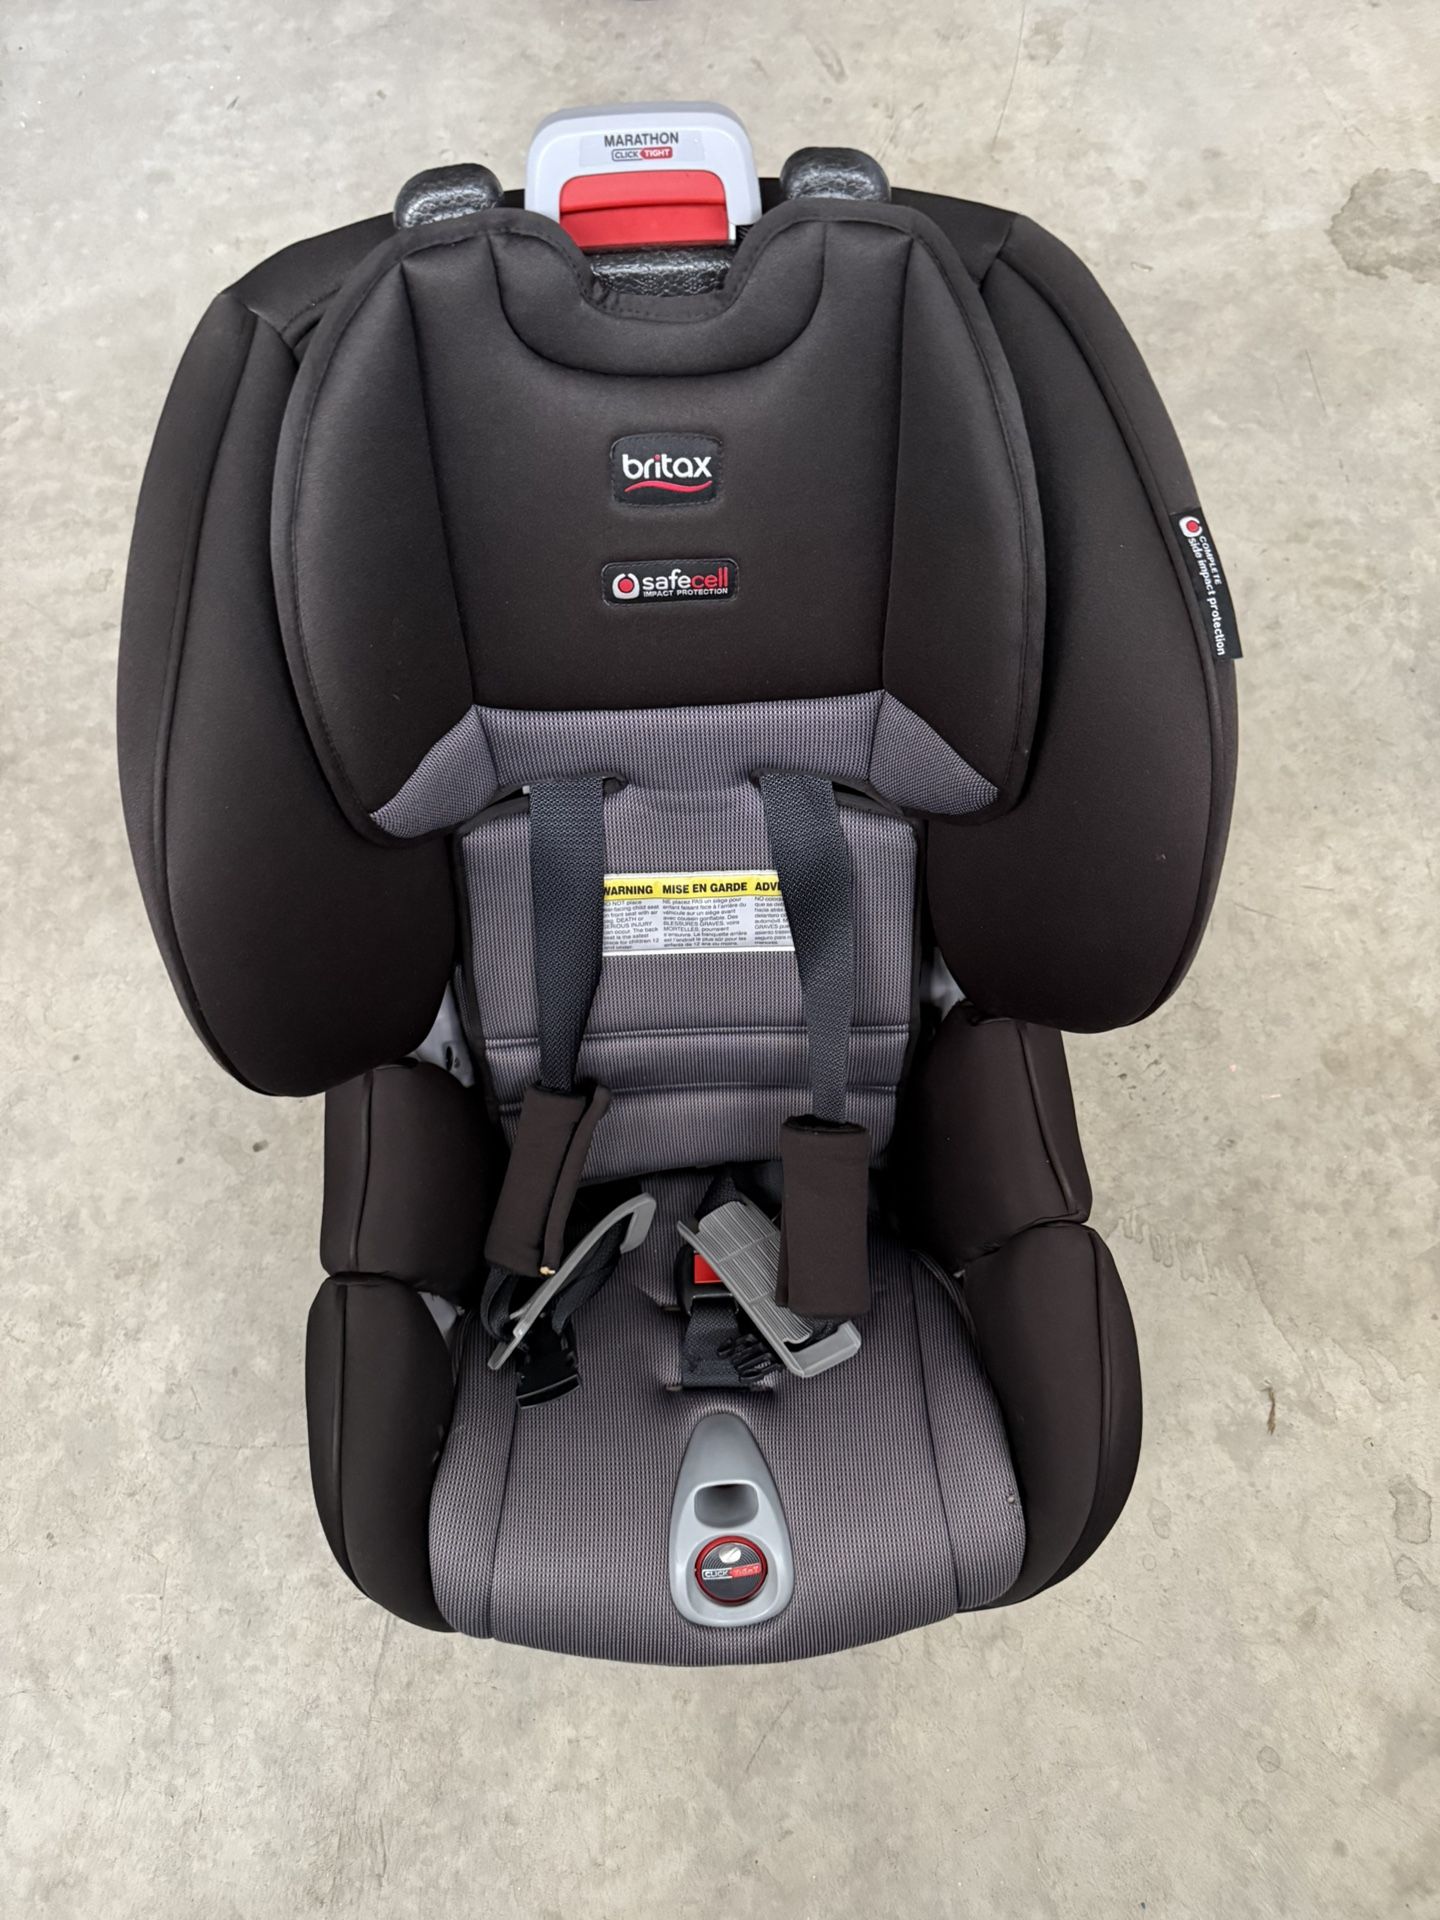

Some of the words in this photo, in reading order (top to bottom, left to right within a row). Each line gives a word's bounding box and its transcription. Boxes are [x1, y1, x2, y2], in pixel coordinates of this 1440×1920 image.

[604, 132, 678, 147] MARATHON
[645, 149, 670, 157] TIGHT
[622, 454, 712, 479] britax
[1199, 536, 1222, 585] COMPLETE
[642, 567, 728, 590] safecell
[1188, 537, 1202, 557] side
[1198, 560, 1216, 595] impact
[1207, 597, 1226, 655] protection
[604, 885, 653, 895] WARNING
[663, 885, 689, 894] MISE
[692, 884, 706, 892] EN
[710, 882, 748, 892] GARDE
